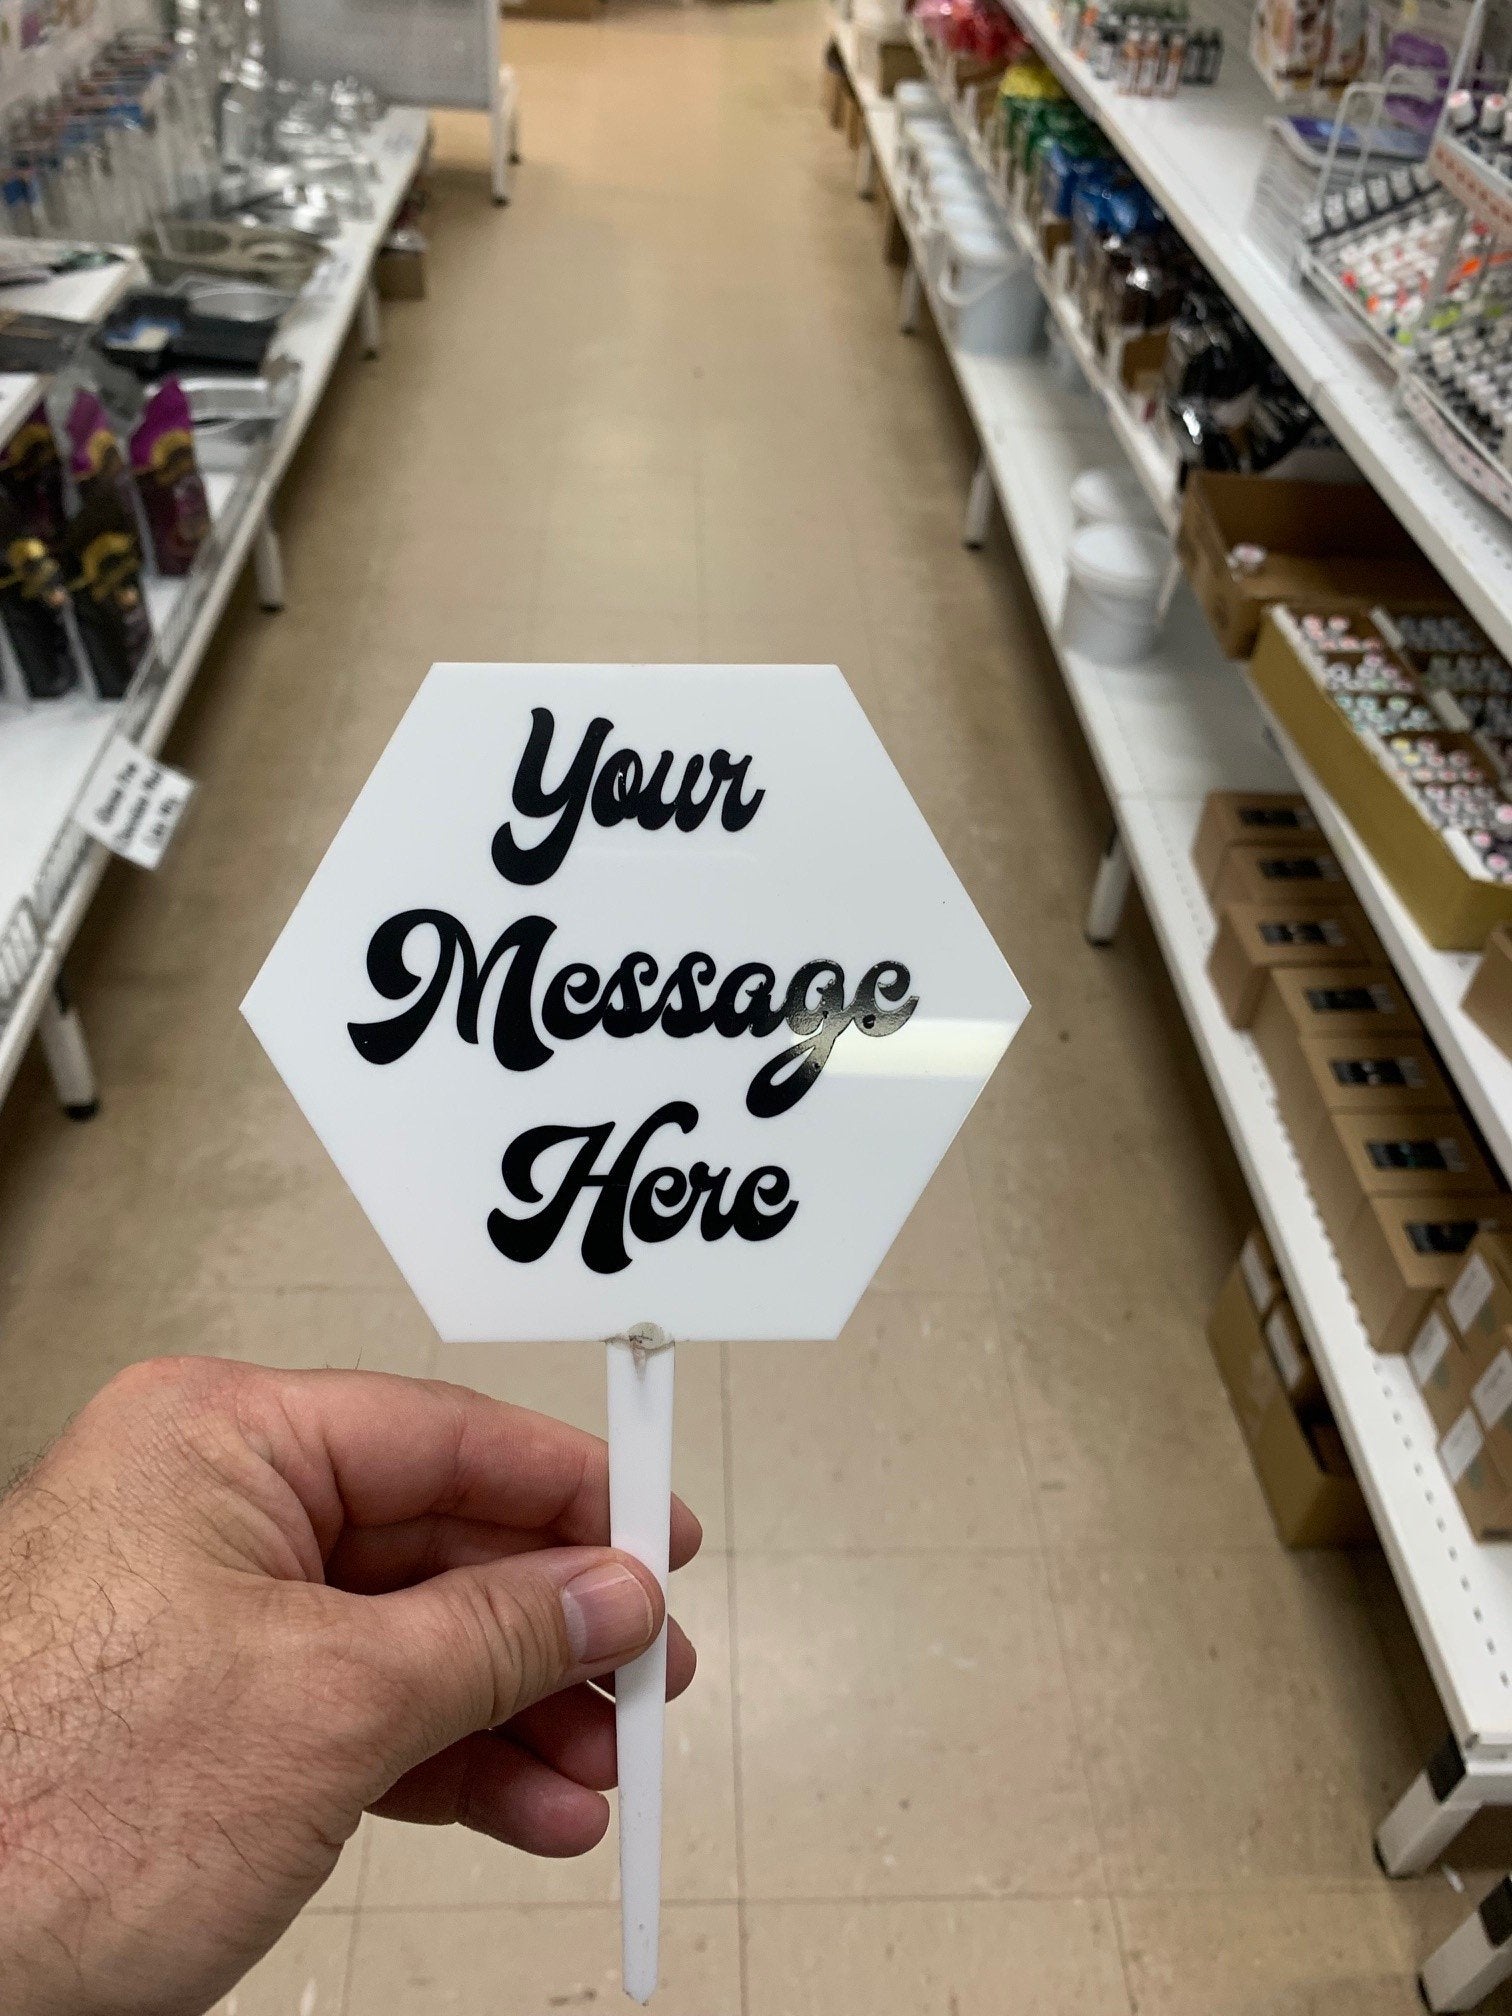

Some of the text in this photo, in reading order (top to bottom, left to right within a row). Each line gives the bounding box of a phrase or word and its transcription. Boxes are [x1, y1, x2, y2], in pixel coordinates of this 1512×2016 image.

[491, 706, 767, 887] Your
[346, 908, 920, 1120] Message
[486, 1100, 800, 1275] Here
